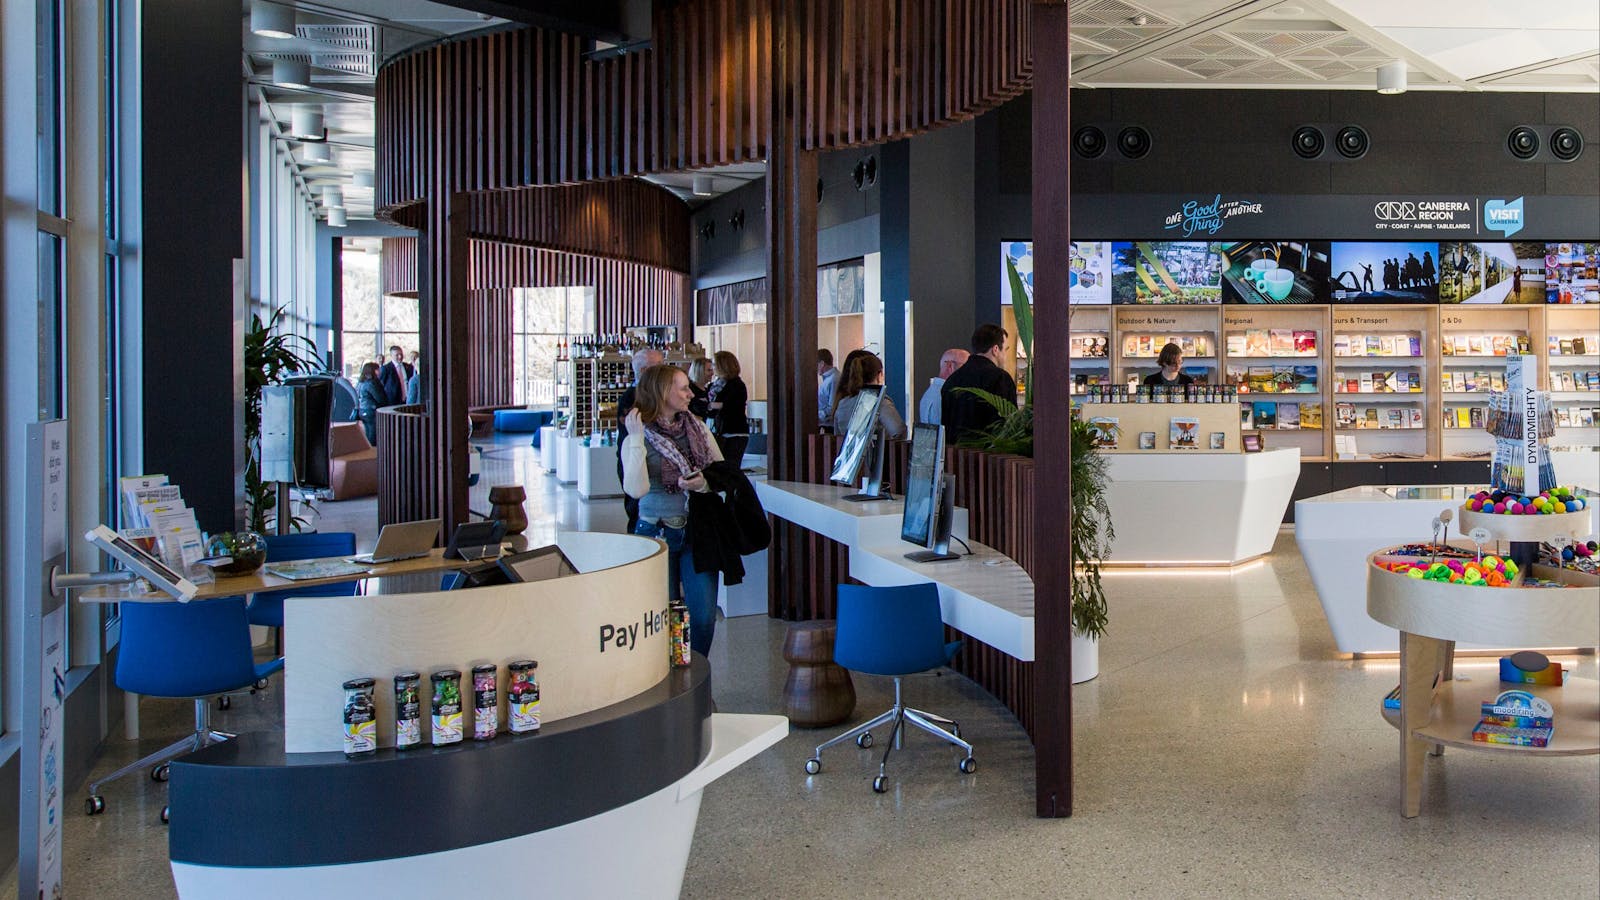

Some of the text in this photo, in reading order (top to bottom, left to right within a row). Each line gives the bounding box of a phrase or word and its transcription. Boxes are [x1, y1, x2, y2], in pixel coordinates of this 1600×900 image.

[1165, 193, 1263, 225] ONE Good AFTER ANOTHER
[1418, 201, 1471, 211] CANBERRA
[1418, 211, 1454, 221] REGION
[1488, 208, 1521, 220] VISIT
[1183, 216, 1223, 238] Thing
[1118, 317, 1145, 325] Outdoor
[1224, 317, 1253, 326] Regional
[1357, 317, 1388, 326] Transport
[1526, 387, 1537, 464] DYNOMIGHTY
[600, 622, 639, 653] Pay
[1494, 706, 1516, 715] mood
[1517, 707, 1535, 718] ring
